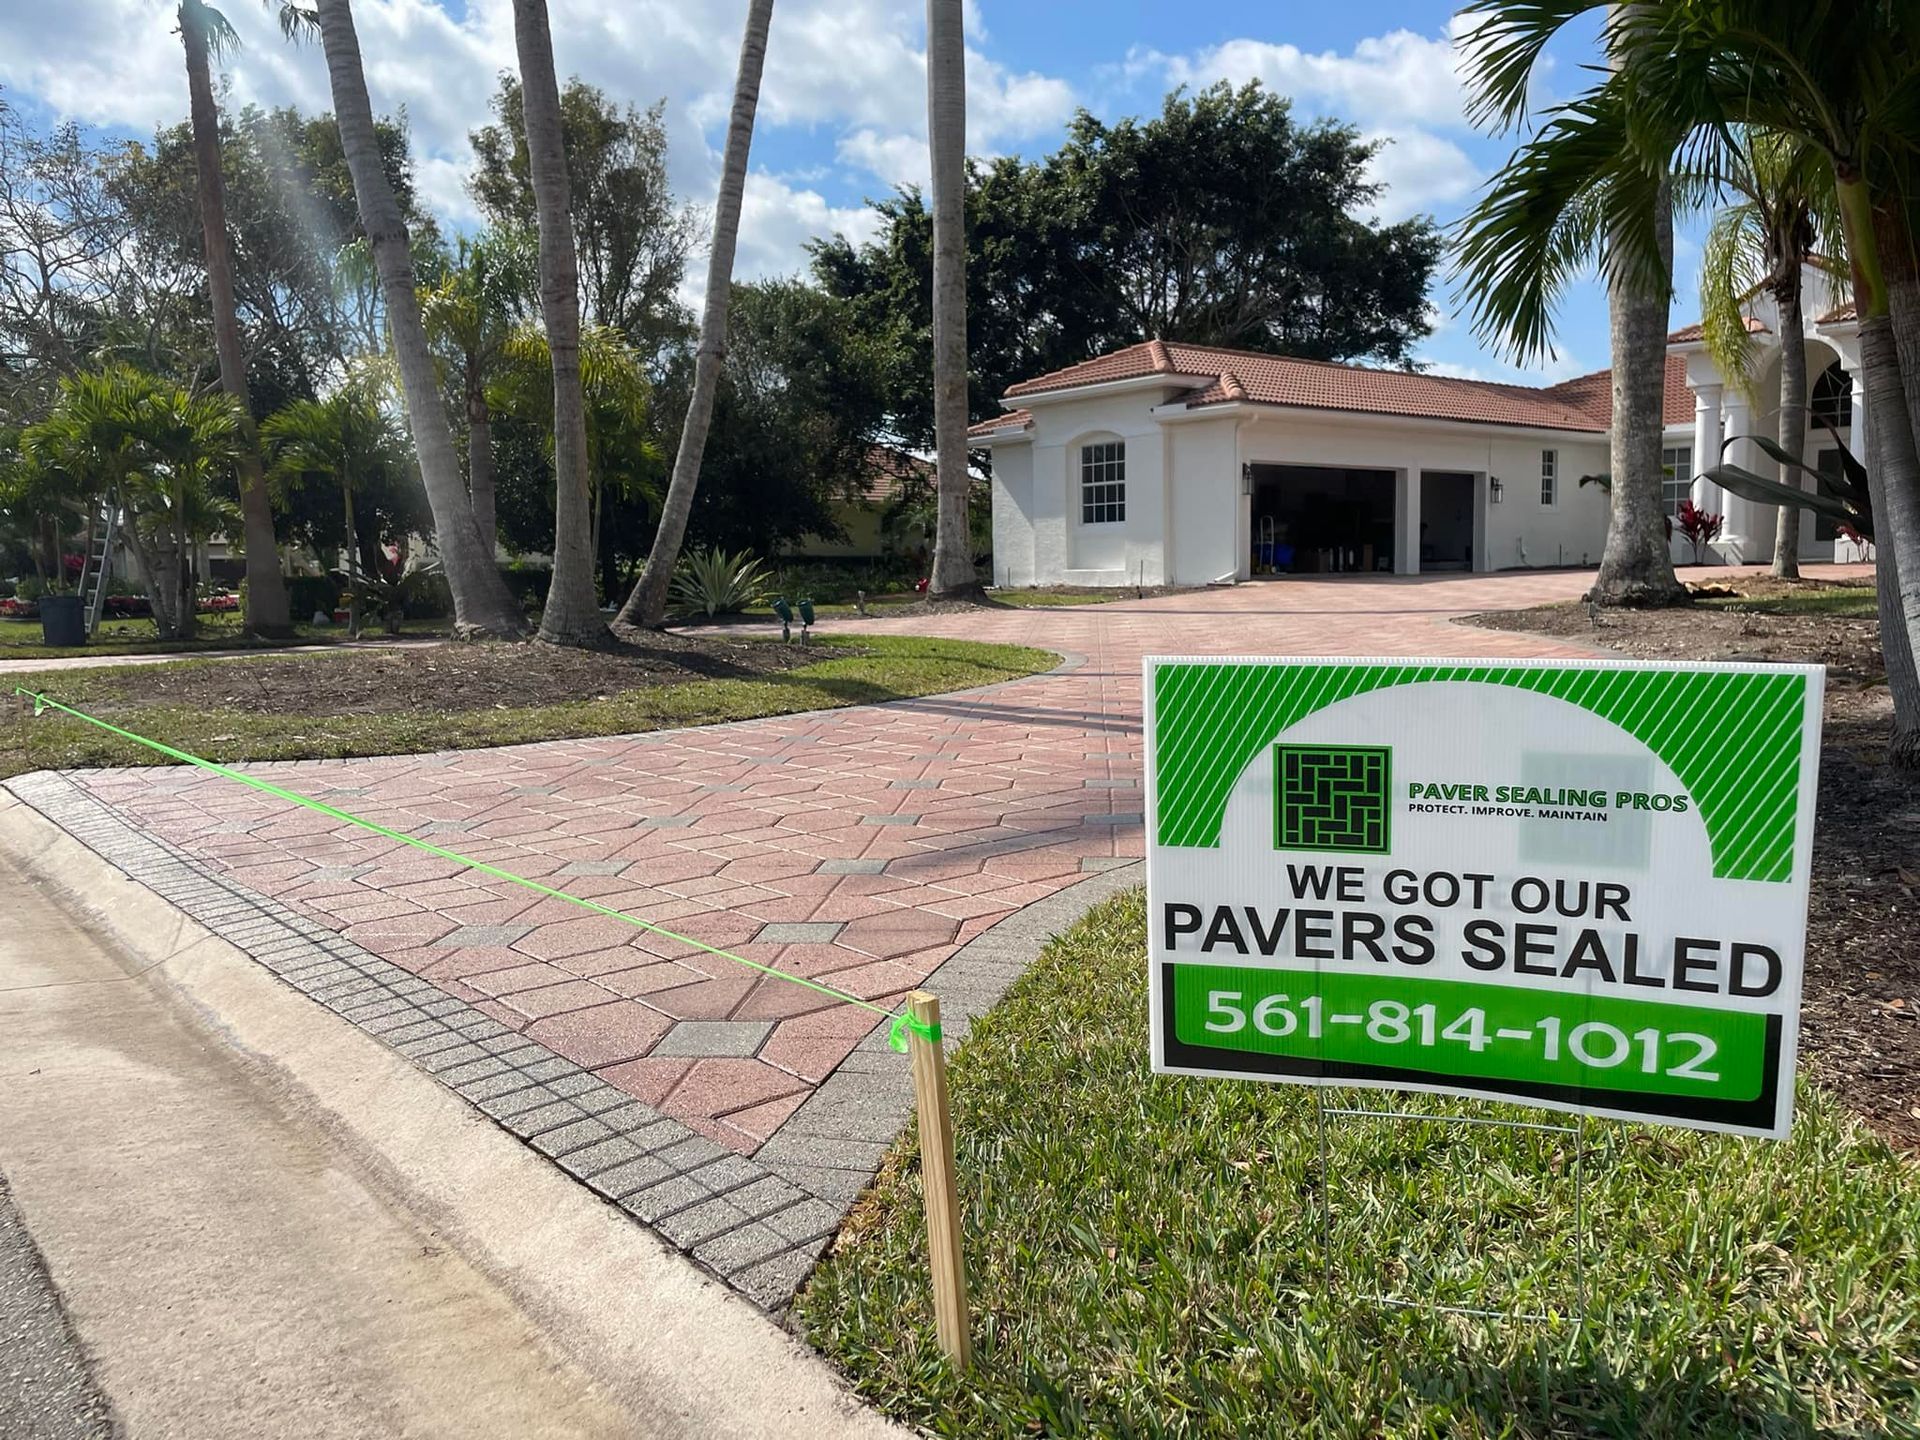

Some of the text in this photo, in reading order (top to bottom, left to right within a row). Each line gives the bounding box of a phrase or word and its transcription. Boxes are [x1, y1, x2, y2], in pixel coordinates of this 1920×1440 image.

[1408, 783, 1688, 812] PAVER SEALING PROS
[1408, 803, 1608, 822] PROTECT. IMPROVE. MAINTAIN
[1286, 864, 1631, 921] WE GOT OUR
[1163, 902, 1783, 998] PAVERS SEALED
[1203, 989, 1720, 1082] 561-814-1012
